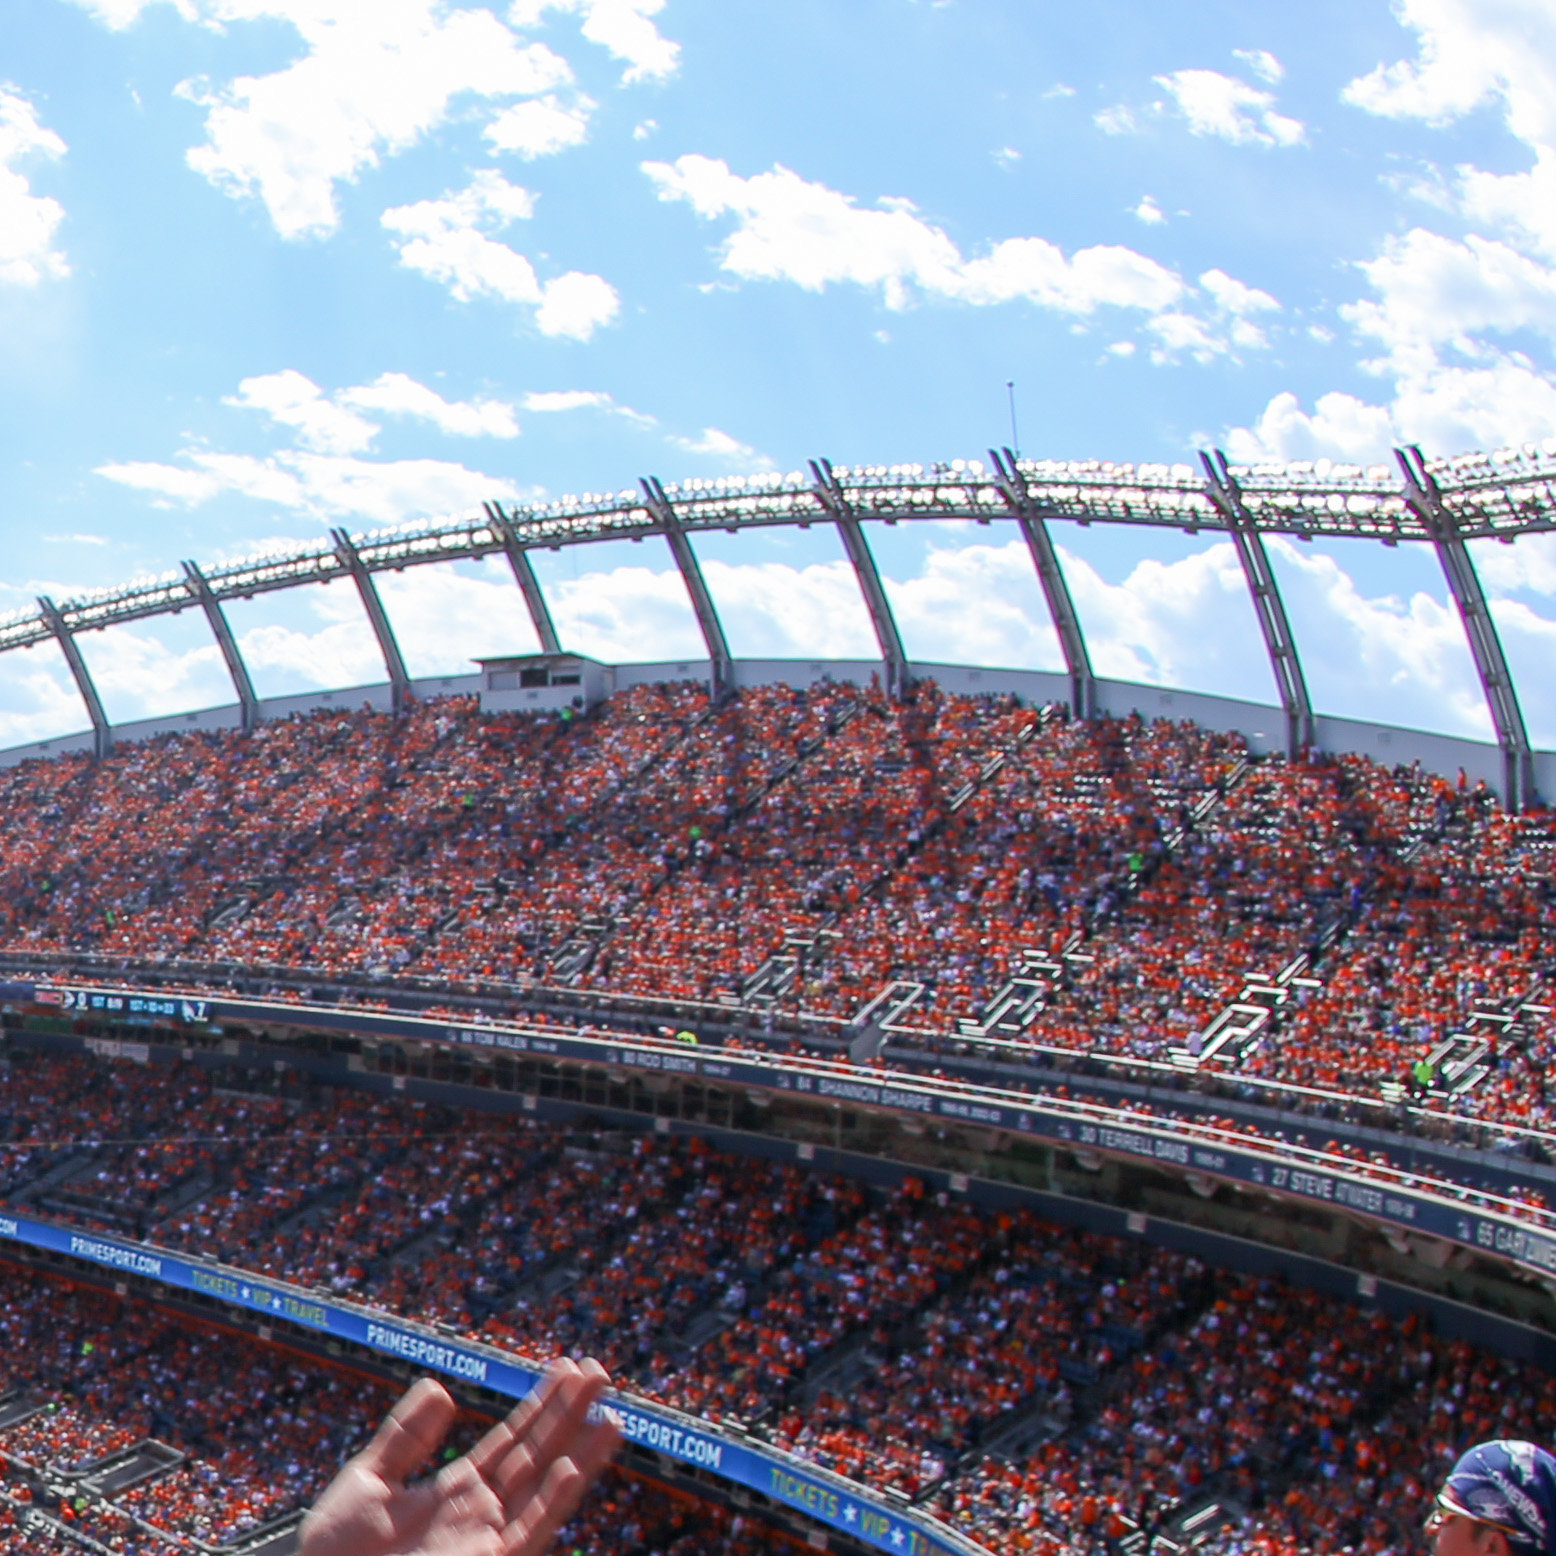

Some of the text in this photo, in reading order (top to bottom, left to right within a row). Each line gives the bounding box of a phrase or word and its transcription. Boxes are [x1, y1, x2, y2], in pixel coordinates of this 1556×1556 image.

[818, 1078, 880, 1103] SHANNON
[881, 1087, 932, 1113] SHARPE
[1099, 1127, 1153, 1157] TERRELL
[1154, 1139, 1188, 1164] DAVIS
[1272, 1167, 1289, 1188] 27
[1290, 1170, 1333, 1199] STEVE
[1335, 1182, 1383, 1212] ATWATER
[71, 1236, 161, 1277] PRIMESPORT.COM
[193, 1270, 330, 1327] TICKETS VIP TRAVEL
[367, 1323, 488, 1381] PRIMESPORT.COM
[769, 1468, 840, 1520] TICKETS
[859, 1510, 891, 1539] VIP
